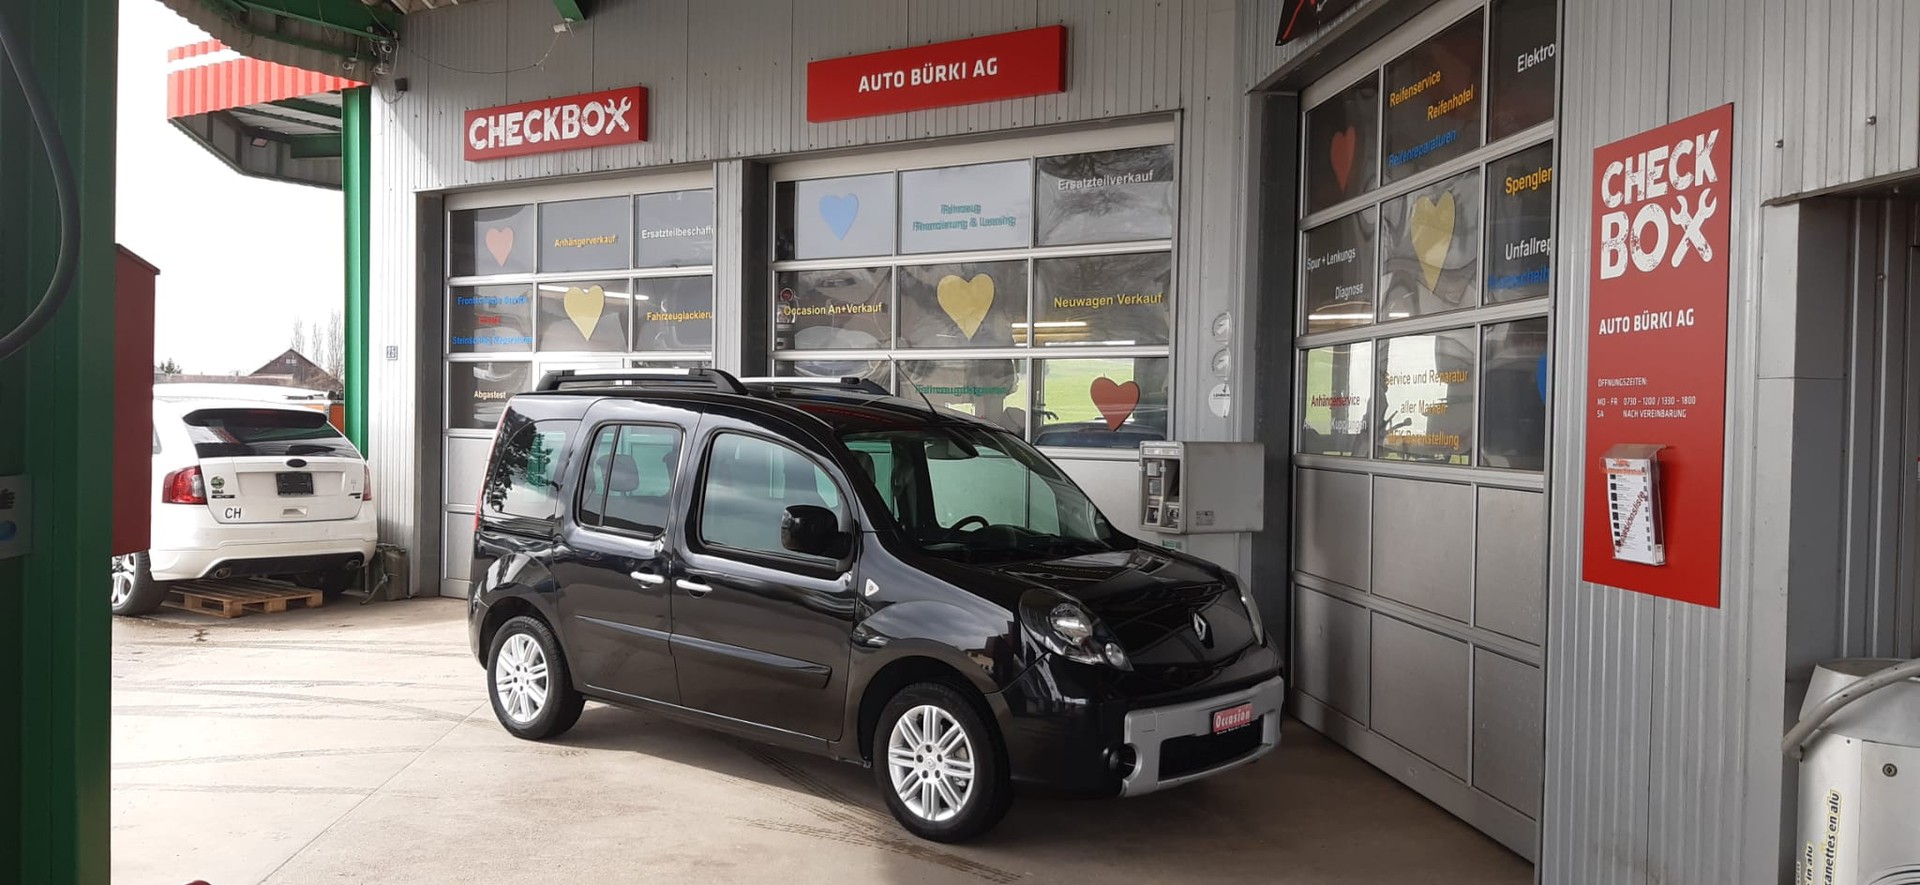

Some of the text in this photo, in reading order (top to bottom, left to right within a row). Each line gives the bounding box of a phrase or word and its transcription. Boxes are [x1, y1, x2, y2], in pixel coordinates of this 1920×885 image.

[858, 57, 998, 93] AUTO BÜRKI AG
[1390, 71, 1441, 107] Reifenservice
[1427, 84, 1474, 121] Reifenhotel
[469, 96, 632, 150] CHECKBOX
[1602, 129, 1719, 208] CHECK
[1058, 170, 1154, 190] Ersatzteilverkauf
[1600, 188, 1716, 279] BOX
[1054, 292, 1163, 309] Neuwagen Verkauf
[1335, 283, 1363, 300] Diagnose
[783, 302, 883, 316] Occasion An+Verkauf
[1599, 308, 1695, 335] AUTO BÜRKI AG
[1385, 368, 1469, 387] Service und Reparatur
[473, 390, 506, 400] Abgastest
[1597, 398, 1606, 406] MO
[1611, 397, 1618, 406] FR
[1661, 395, 1675, 405] 1330
[1400, 399, 1448, 414] aller Marken
[1597, 408, 1687, 418] SA NACH VEREINBARUNG
[225, 507, 242, 519] CH
[1216, 709, 1250, 728] Occasion
[1828, 792, 1840, 815] alu
[1828, 815, 1838, 833] en
[1806, 845, 1814, 866] alu
